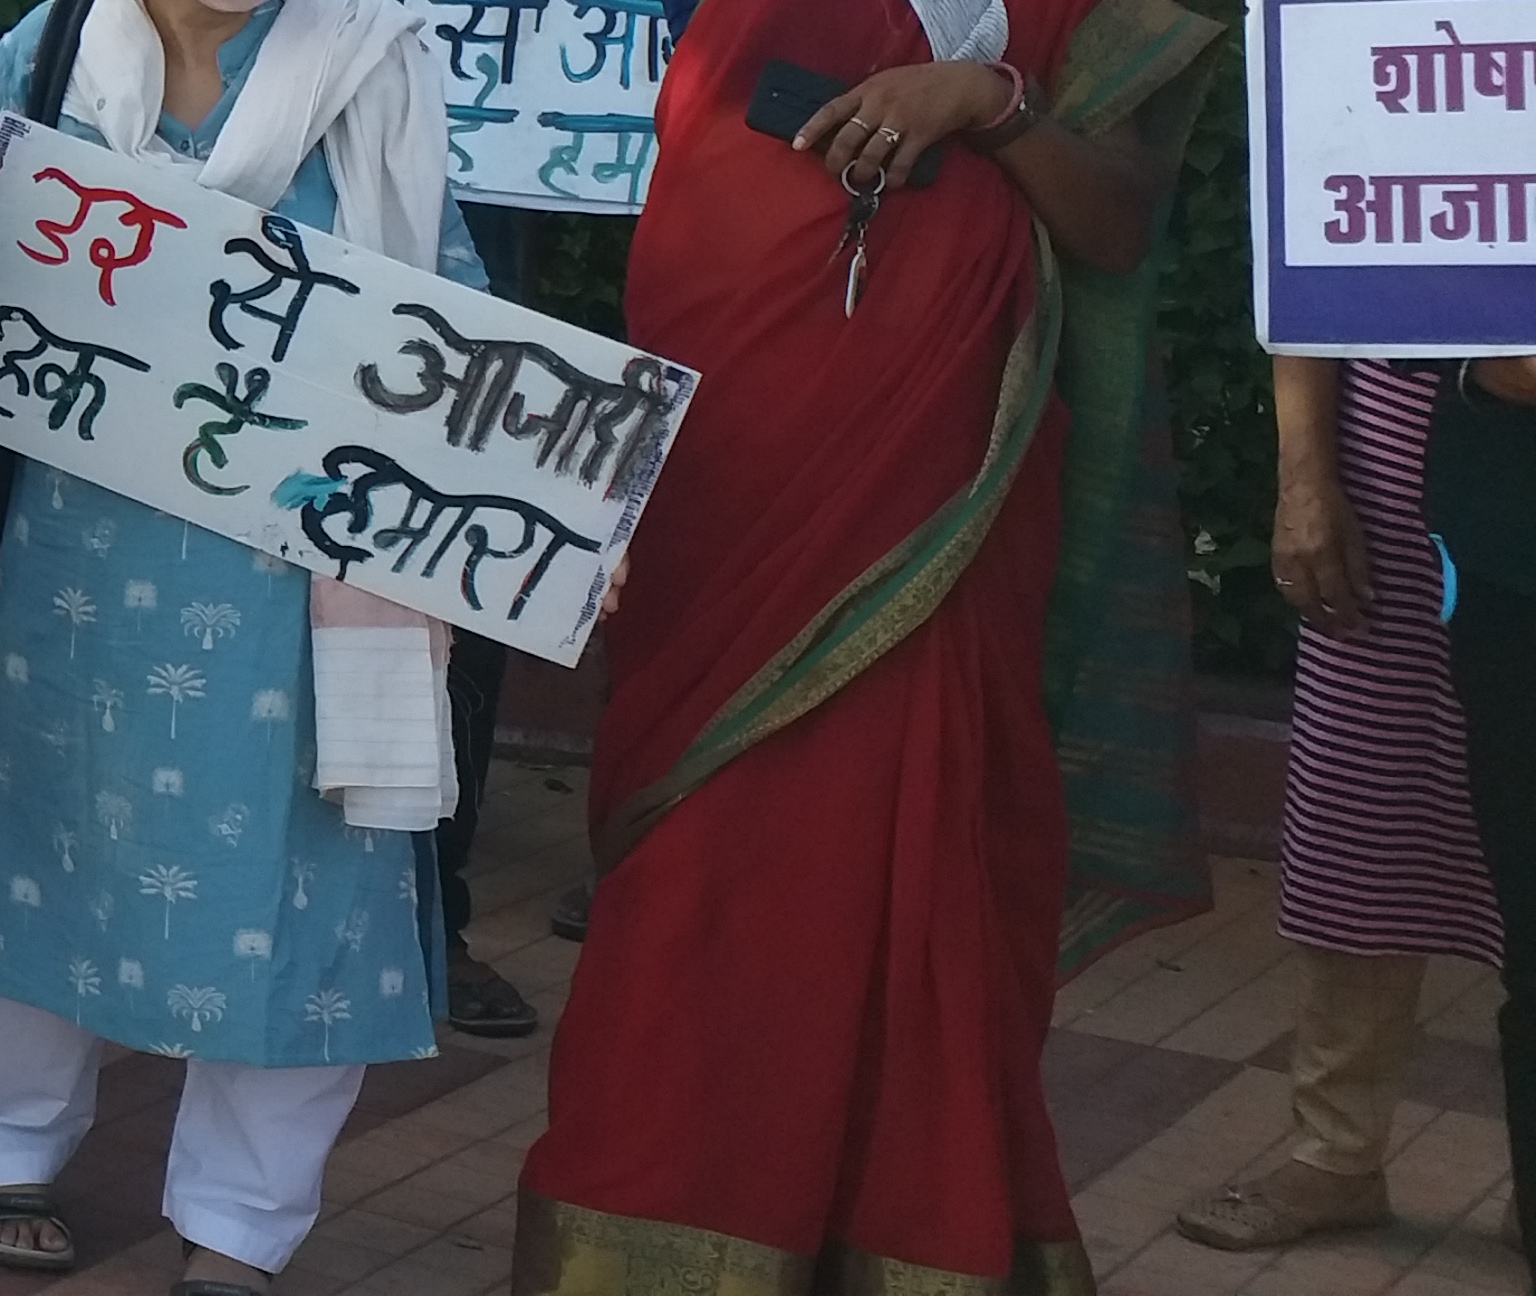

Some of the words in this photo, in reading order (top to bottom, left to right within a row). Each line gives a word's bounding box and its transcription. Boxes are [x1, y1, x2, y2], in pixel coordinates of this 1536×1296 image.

[1371, 20, 1536, 114] शोष
[17, 167, 188, 306] डर
[209, 215, 361, 363] से
[1324, 174, 1536, 244] आजा
[173, 362, 308, 496] है
[301, 445, 601, 620] हमारा
